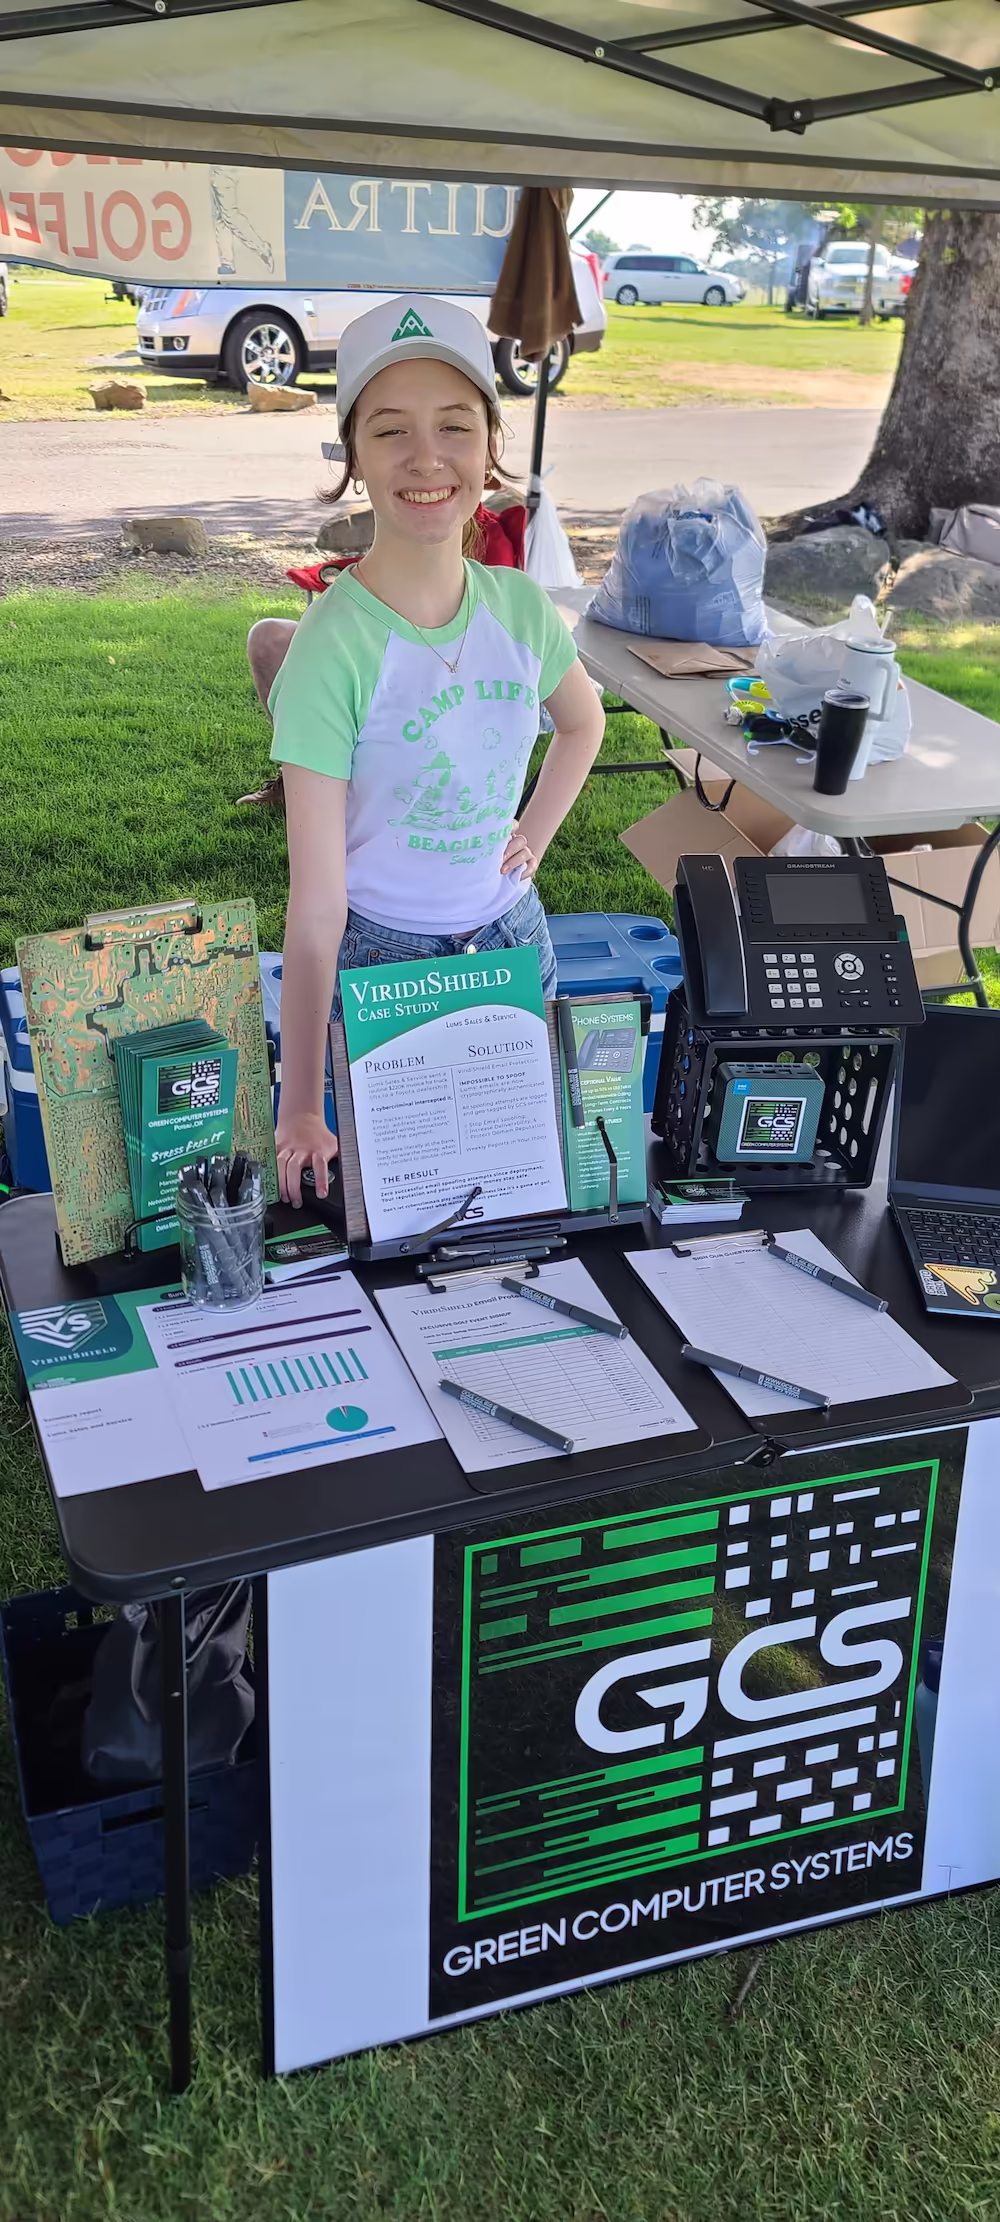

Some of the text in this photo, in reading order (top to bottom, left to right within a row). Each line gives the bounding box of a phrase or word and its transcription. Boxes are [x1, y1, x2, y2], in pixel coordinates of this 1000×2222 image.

[402, 680, 536, 742] CAMP LIFE
[408, 834, 482, 852] BEAGLE
[350, 968, 512, 1005] VIRIDISHIELD
[357, 1001, 440, 1022] CASE STUDY
[446, 1020, 462, 1029] LUMS
[464, 1016, 482, 1026] SALES
[492, 1012, 518, 1022] SERVICE
[571, 1013, 634, 1026] PHONE SYSTEMS
[468, 1039, 534, 1058] SOLUTION
[364, 1055, 425, 1074] PROBLEM
[172, 1074, 220, 1096] GCS
[459, 1076, 494, 1086] IMPOSSIBLE
[506, 1071, 525, 1079] SPOOF
[376, 1101, 414, 1112] cybercriminal
[414, 1095, 445, 1106] intercepted
[148, 1107, 229, 1129] GREEN COMPUTER SYSTEMS
[757, 1116, 796, 1128] GCS
[151, 1130, 226, 1162] STRESS FREE IT
[382, 1168, 439, 1184] THE RESULT
[394, 1185, 423, 1195] successful
[441, 1177, 465, 1186] spoofing
[467, 1173, 492, 1182] attempts
[395, 1190, 425, 1200] reputation
[483, 1177, 501, 1185] money
[920, 1270, 934, 1293] CRYPTO
[933, 1282, 944, 1295] BRO
[411, 1294, 498, 1316] VIRIDISHIELD Email
[420, 1311, 512, 1331] EXCLUSIVE GOLF EVENT SIGNUP
[31, 1346, 117, 1366] VIRIDISHIELD
[574, 1596, 912, 1754] GCS
[443, 1832, 914, 1977] GREEN COMPUTER SYSTEMS
